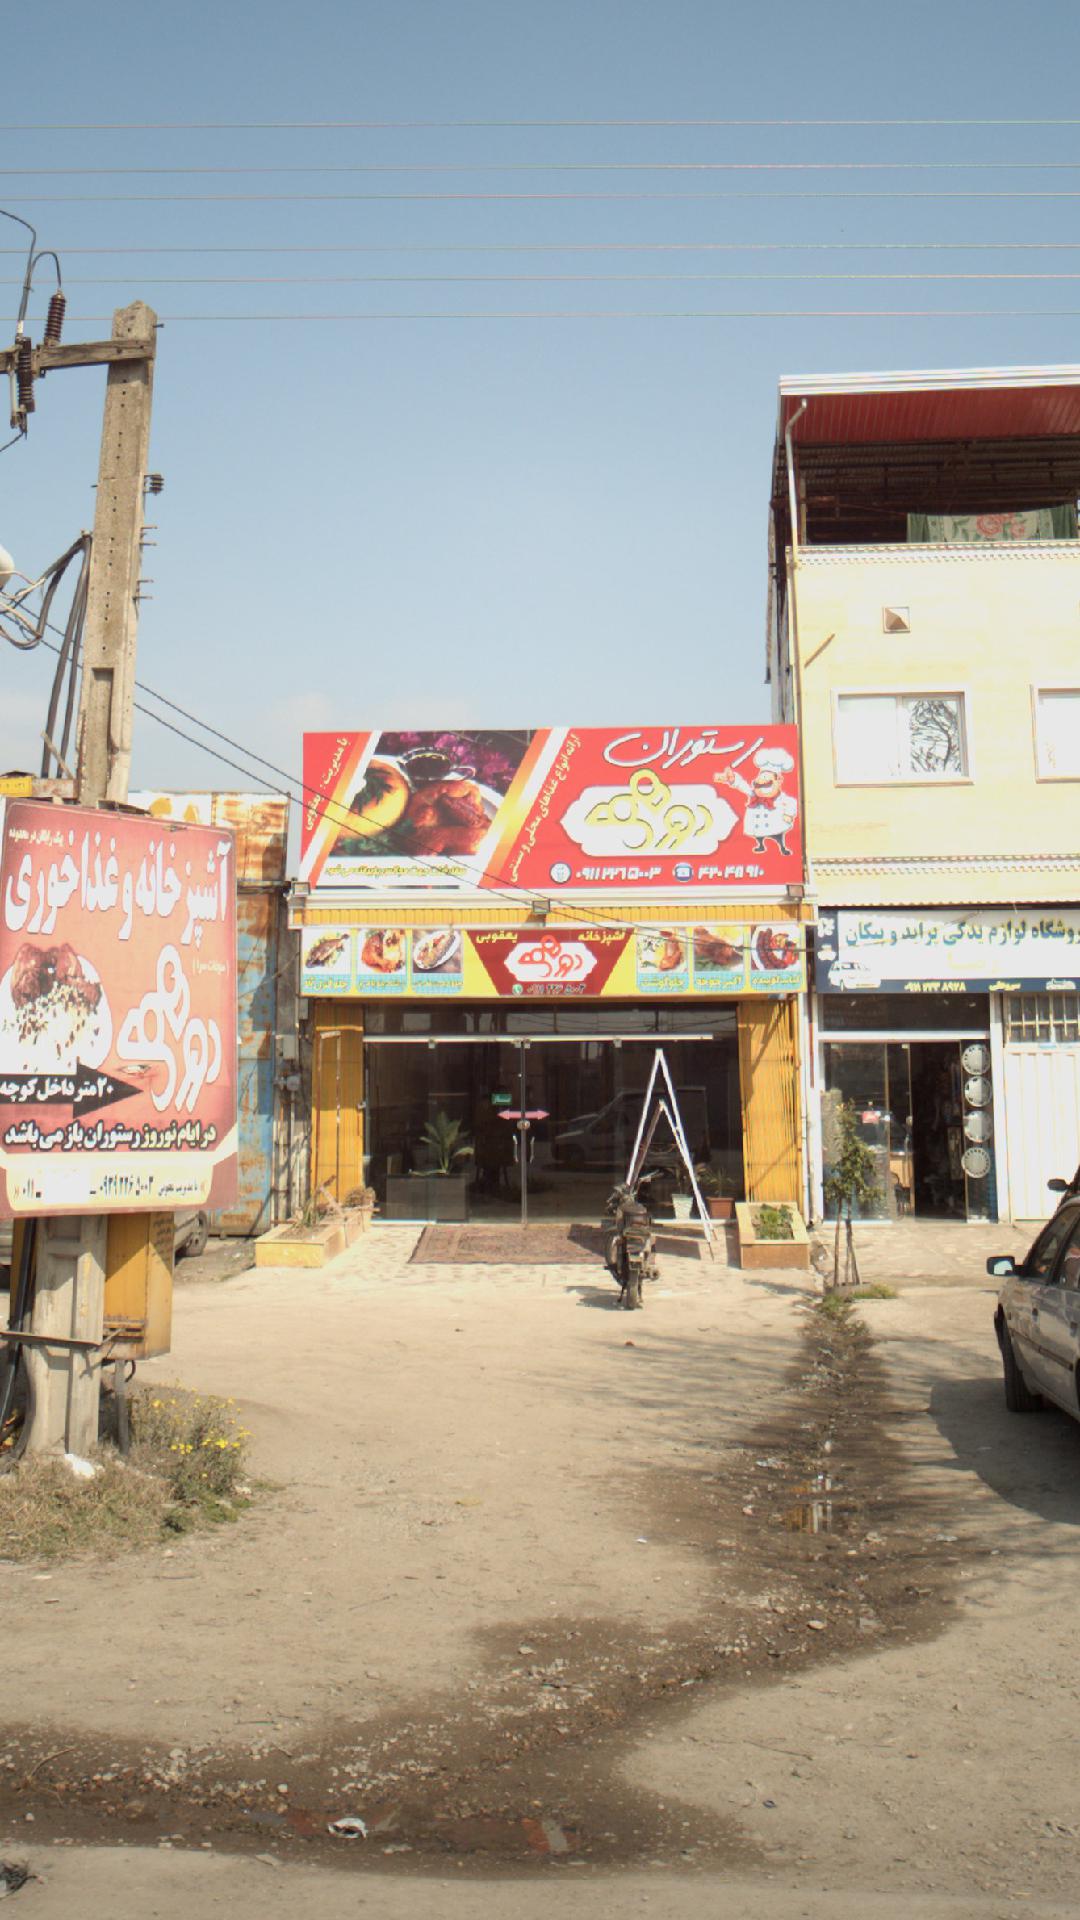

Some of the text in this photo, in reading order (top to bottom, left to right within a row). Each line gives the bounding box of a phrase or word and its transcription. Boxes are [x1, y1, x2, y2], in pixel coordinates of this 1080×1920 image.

[603, 727, 764, 769] رستوران
[525, 815, 541, 847] محلی
[509, 851, 524, 882] سنتی
[118, 871, 133, 941] و
[135, 840, 232, 950] آشپزخانه
[889, 929, 898, 946] و
[943, 921, 983, 945] یدکی
[989, 917, 1026, 945] لوازم
[0, 1077, 114, 1102] ۲۰ متر داخل کوچه
[63, 1120, 84, 1148] باز
[84, 1120, 141, 1149] رستوران
[140, 1121, 177, 1149] نوروز
[177, 1120, 200, 1147] ایام
[200, 1123, 217, 1148] در
